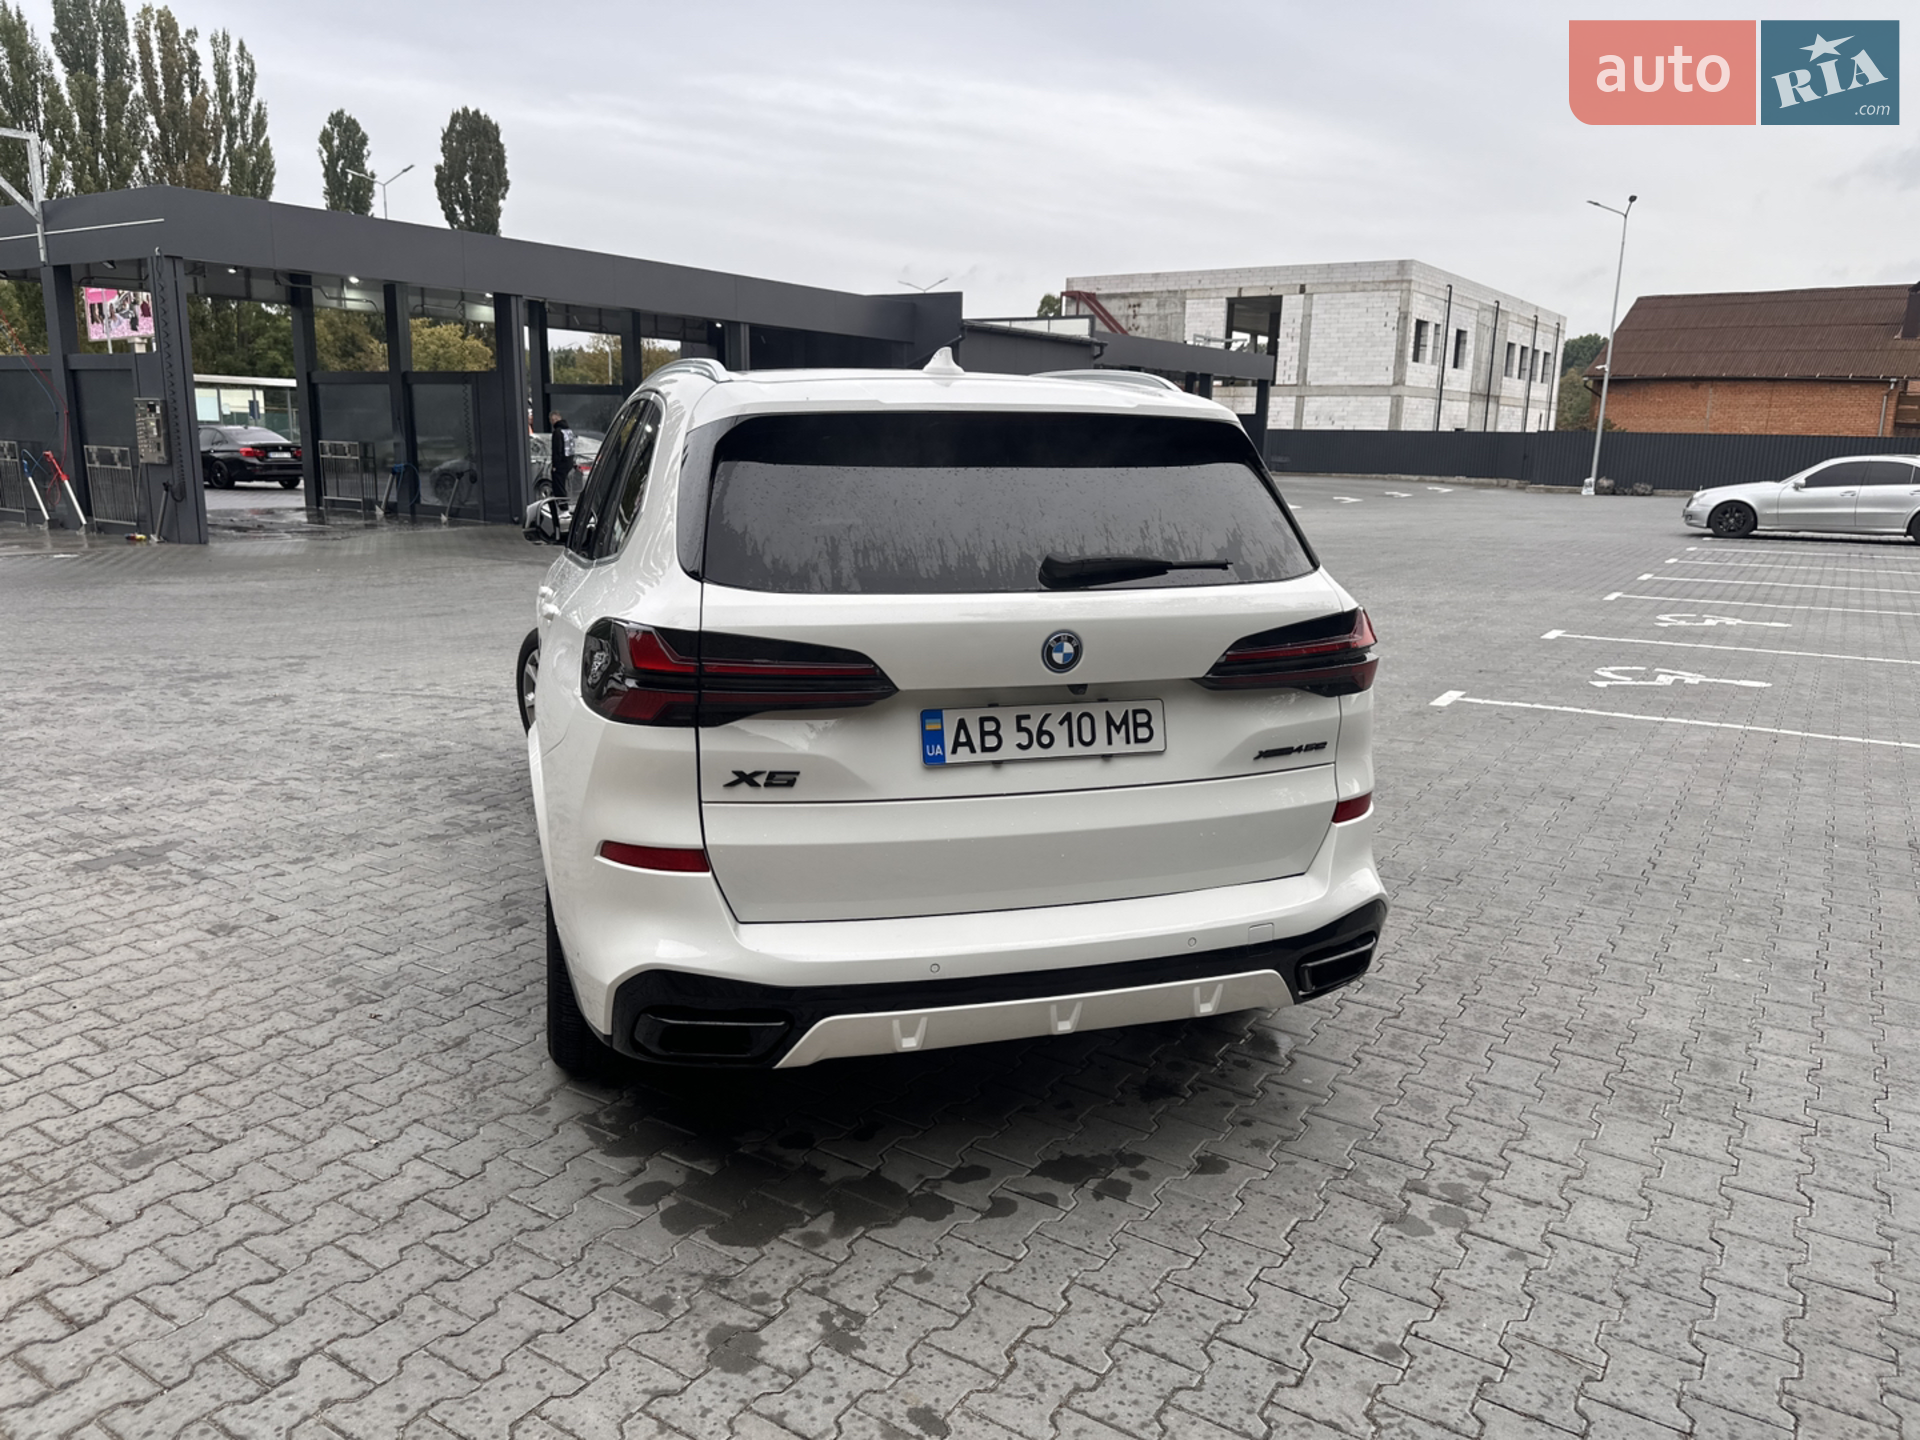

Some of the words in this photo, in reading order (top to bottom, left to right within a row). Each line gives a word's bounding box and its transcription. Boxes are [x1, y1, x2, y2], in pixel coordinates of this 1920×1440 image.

[950, 715, 1003, 755] AB
[1015, 711, 1096, 751] 5610
[1105, 708, 1154, 746] MB
[926, 744, 943, 757] UA
[723, 770, 800, 788] X5
